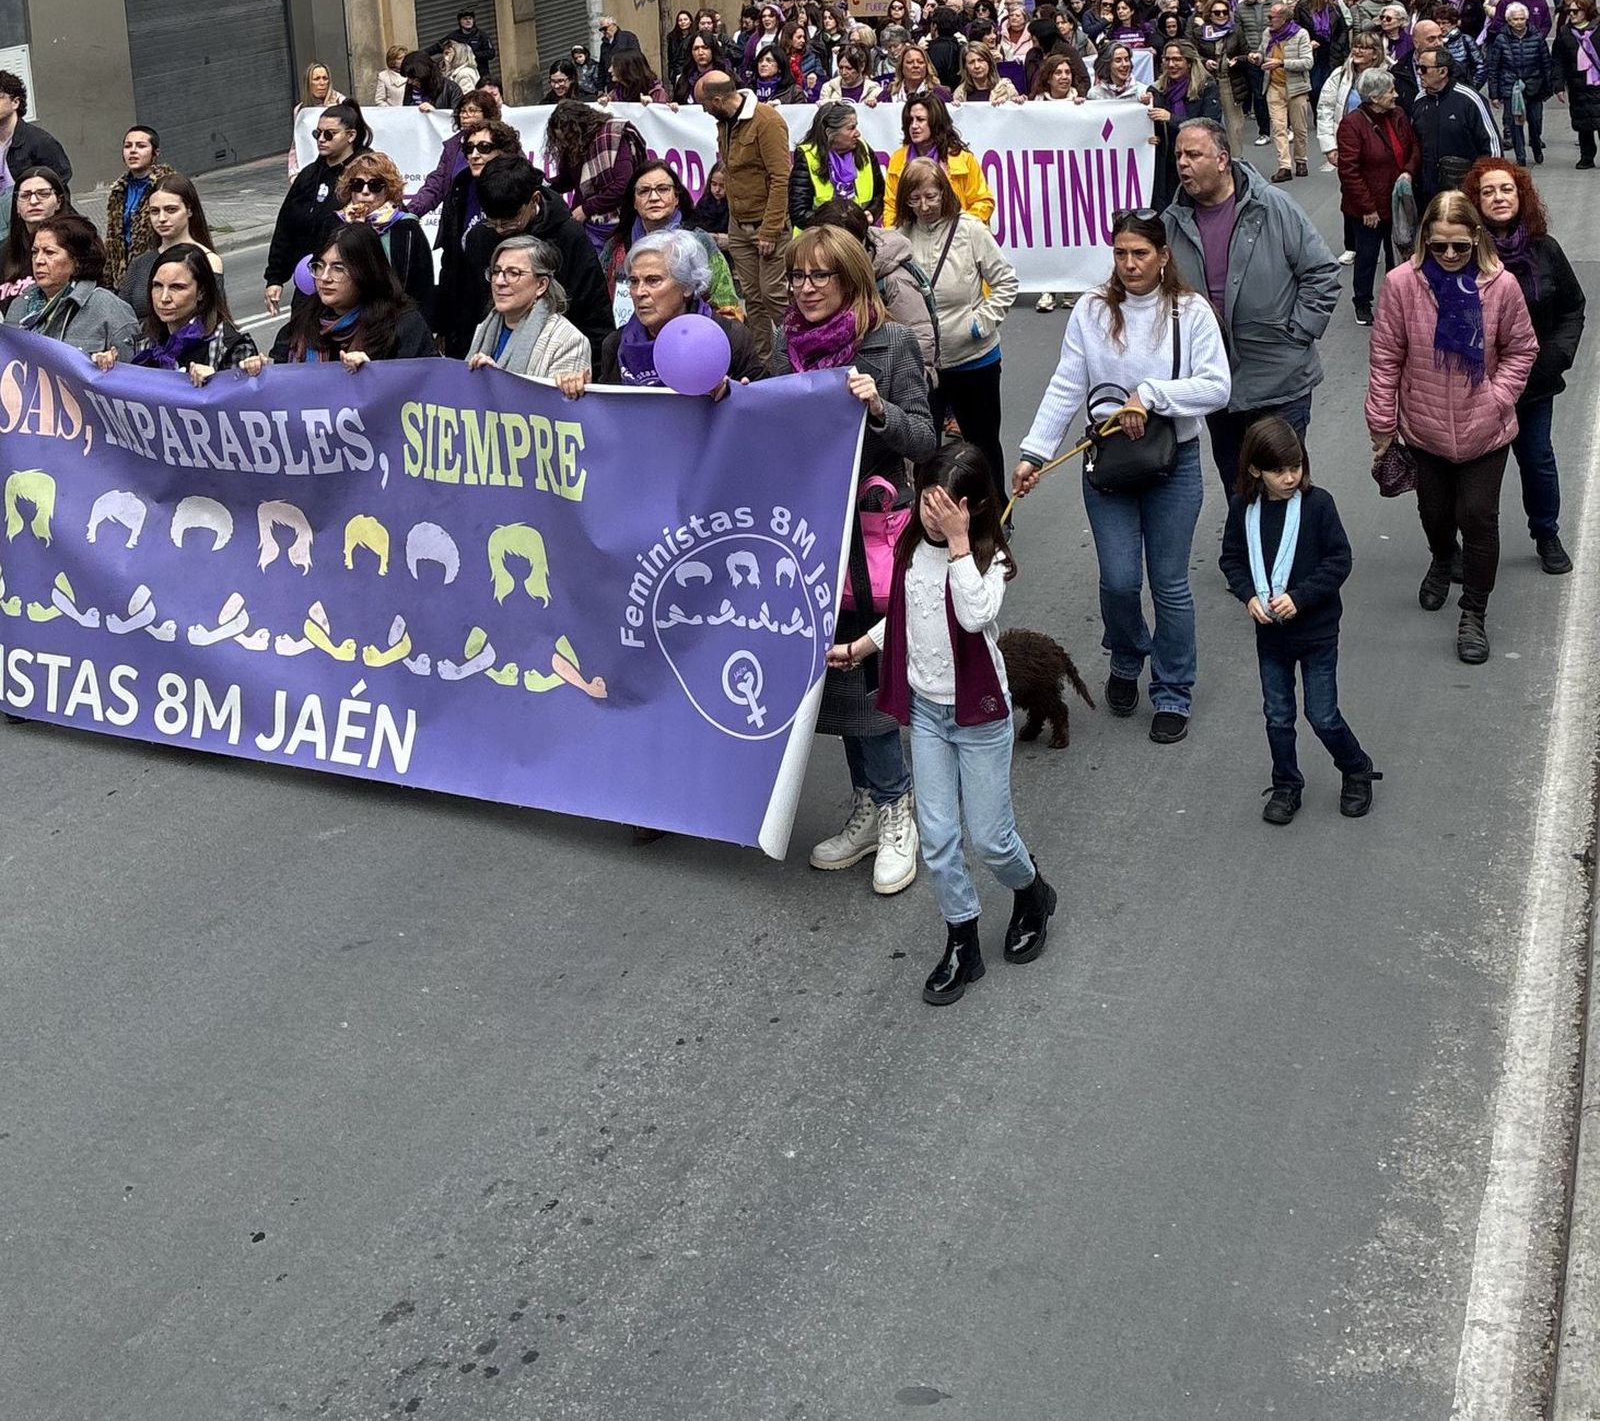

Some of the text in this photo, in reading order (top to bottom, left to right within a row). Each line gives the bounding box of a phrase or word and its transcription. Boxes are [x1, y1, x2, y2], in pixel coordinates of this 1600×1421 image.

[982, 117, 1143, 249] ONTINÚA
[83, 389, 390, 489] IMPARABLES,
[400, 401, 588, 502] SIEMPRE
[620, 506, 835, 653] Feministas 8M Jae
[154, 672, 243, 745] 8M
[255, 677, 418, 775] JAÉN
